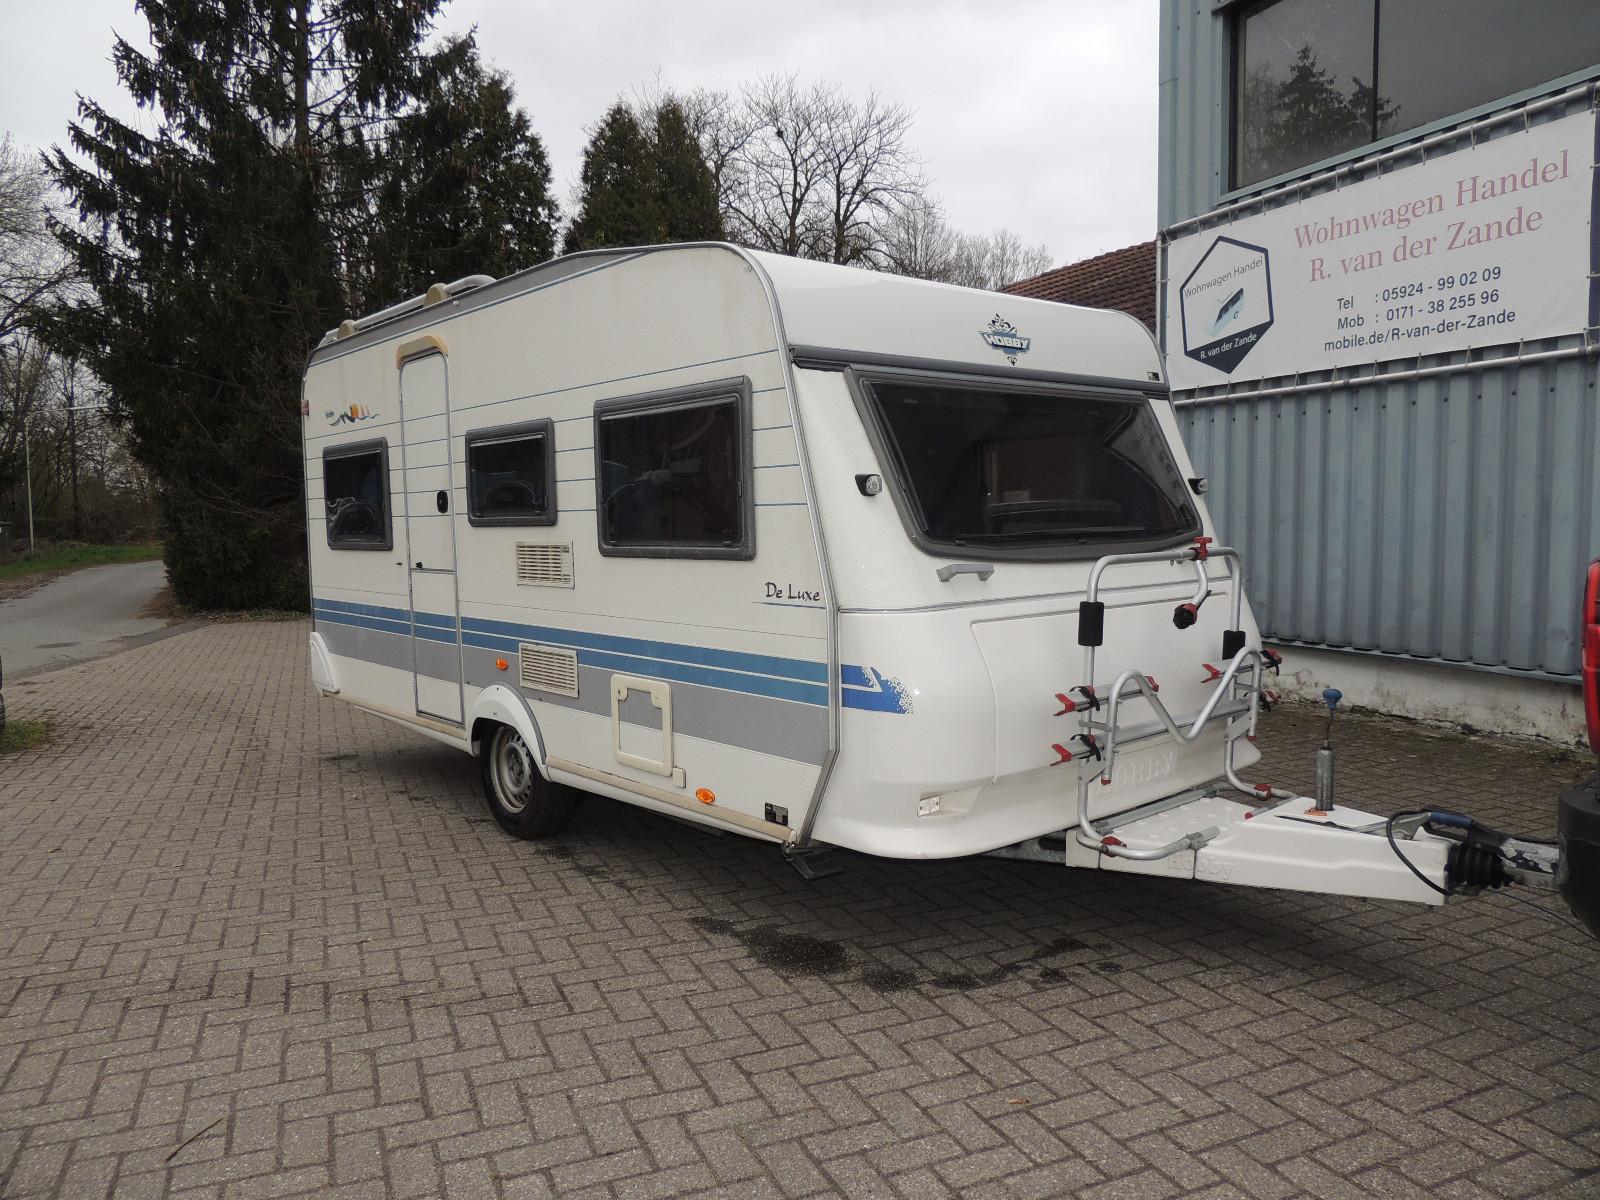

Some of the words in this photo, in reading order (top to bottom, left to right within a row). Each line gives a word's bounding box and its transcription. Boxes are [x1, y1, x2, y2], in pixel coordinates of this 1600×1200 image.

[1293, 195, 1445, 249] Wohnwagen
[1455, 149, 1570, 207] Handel
[1309, 257, 1332, 283] R.
[1340, 249, 1384, 275] van
[1392, 235, 1438, 263] der
[1446, 206, 1544, 251] Zande
[1184, 272, 1232, 299] Wohnwagen
[1233, 256, 1263, 278] Handel
[1337, 296, 1354, 311] Tel
[1382, 282, 1424, 302] 05924
[1437, 276, 1455, 291] 99
[1459, 271, 1478, 287] 02
[1482, 266, 1502, 282] 09
[1324, 309, 1516, 352] mobile.de/R-van-der-Zande
[1337, 314, 1365, 330] Mob
[1386, 304, 1415, 322] 0171
[1427, 300, 1445, 314] 38
[1449, 294, 1476, 310] 255
[1480, 289, 1500, 304] 96
[983, 334, 1029, 349] HOBBY
[1200, 350, 1207, 360] R.
[1208, 347, 1220, 357] van
[1221, 342, 1233, 352] der
[1234, 332, 1257, 348] Zande
[765, 581, 783, 599] De
[787, 583, 821, 602] Luxe
